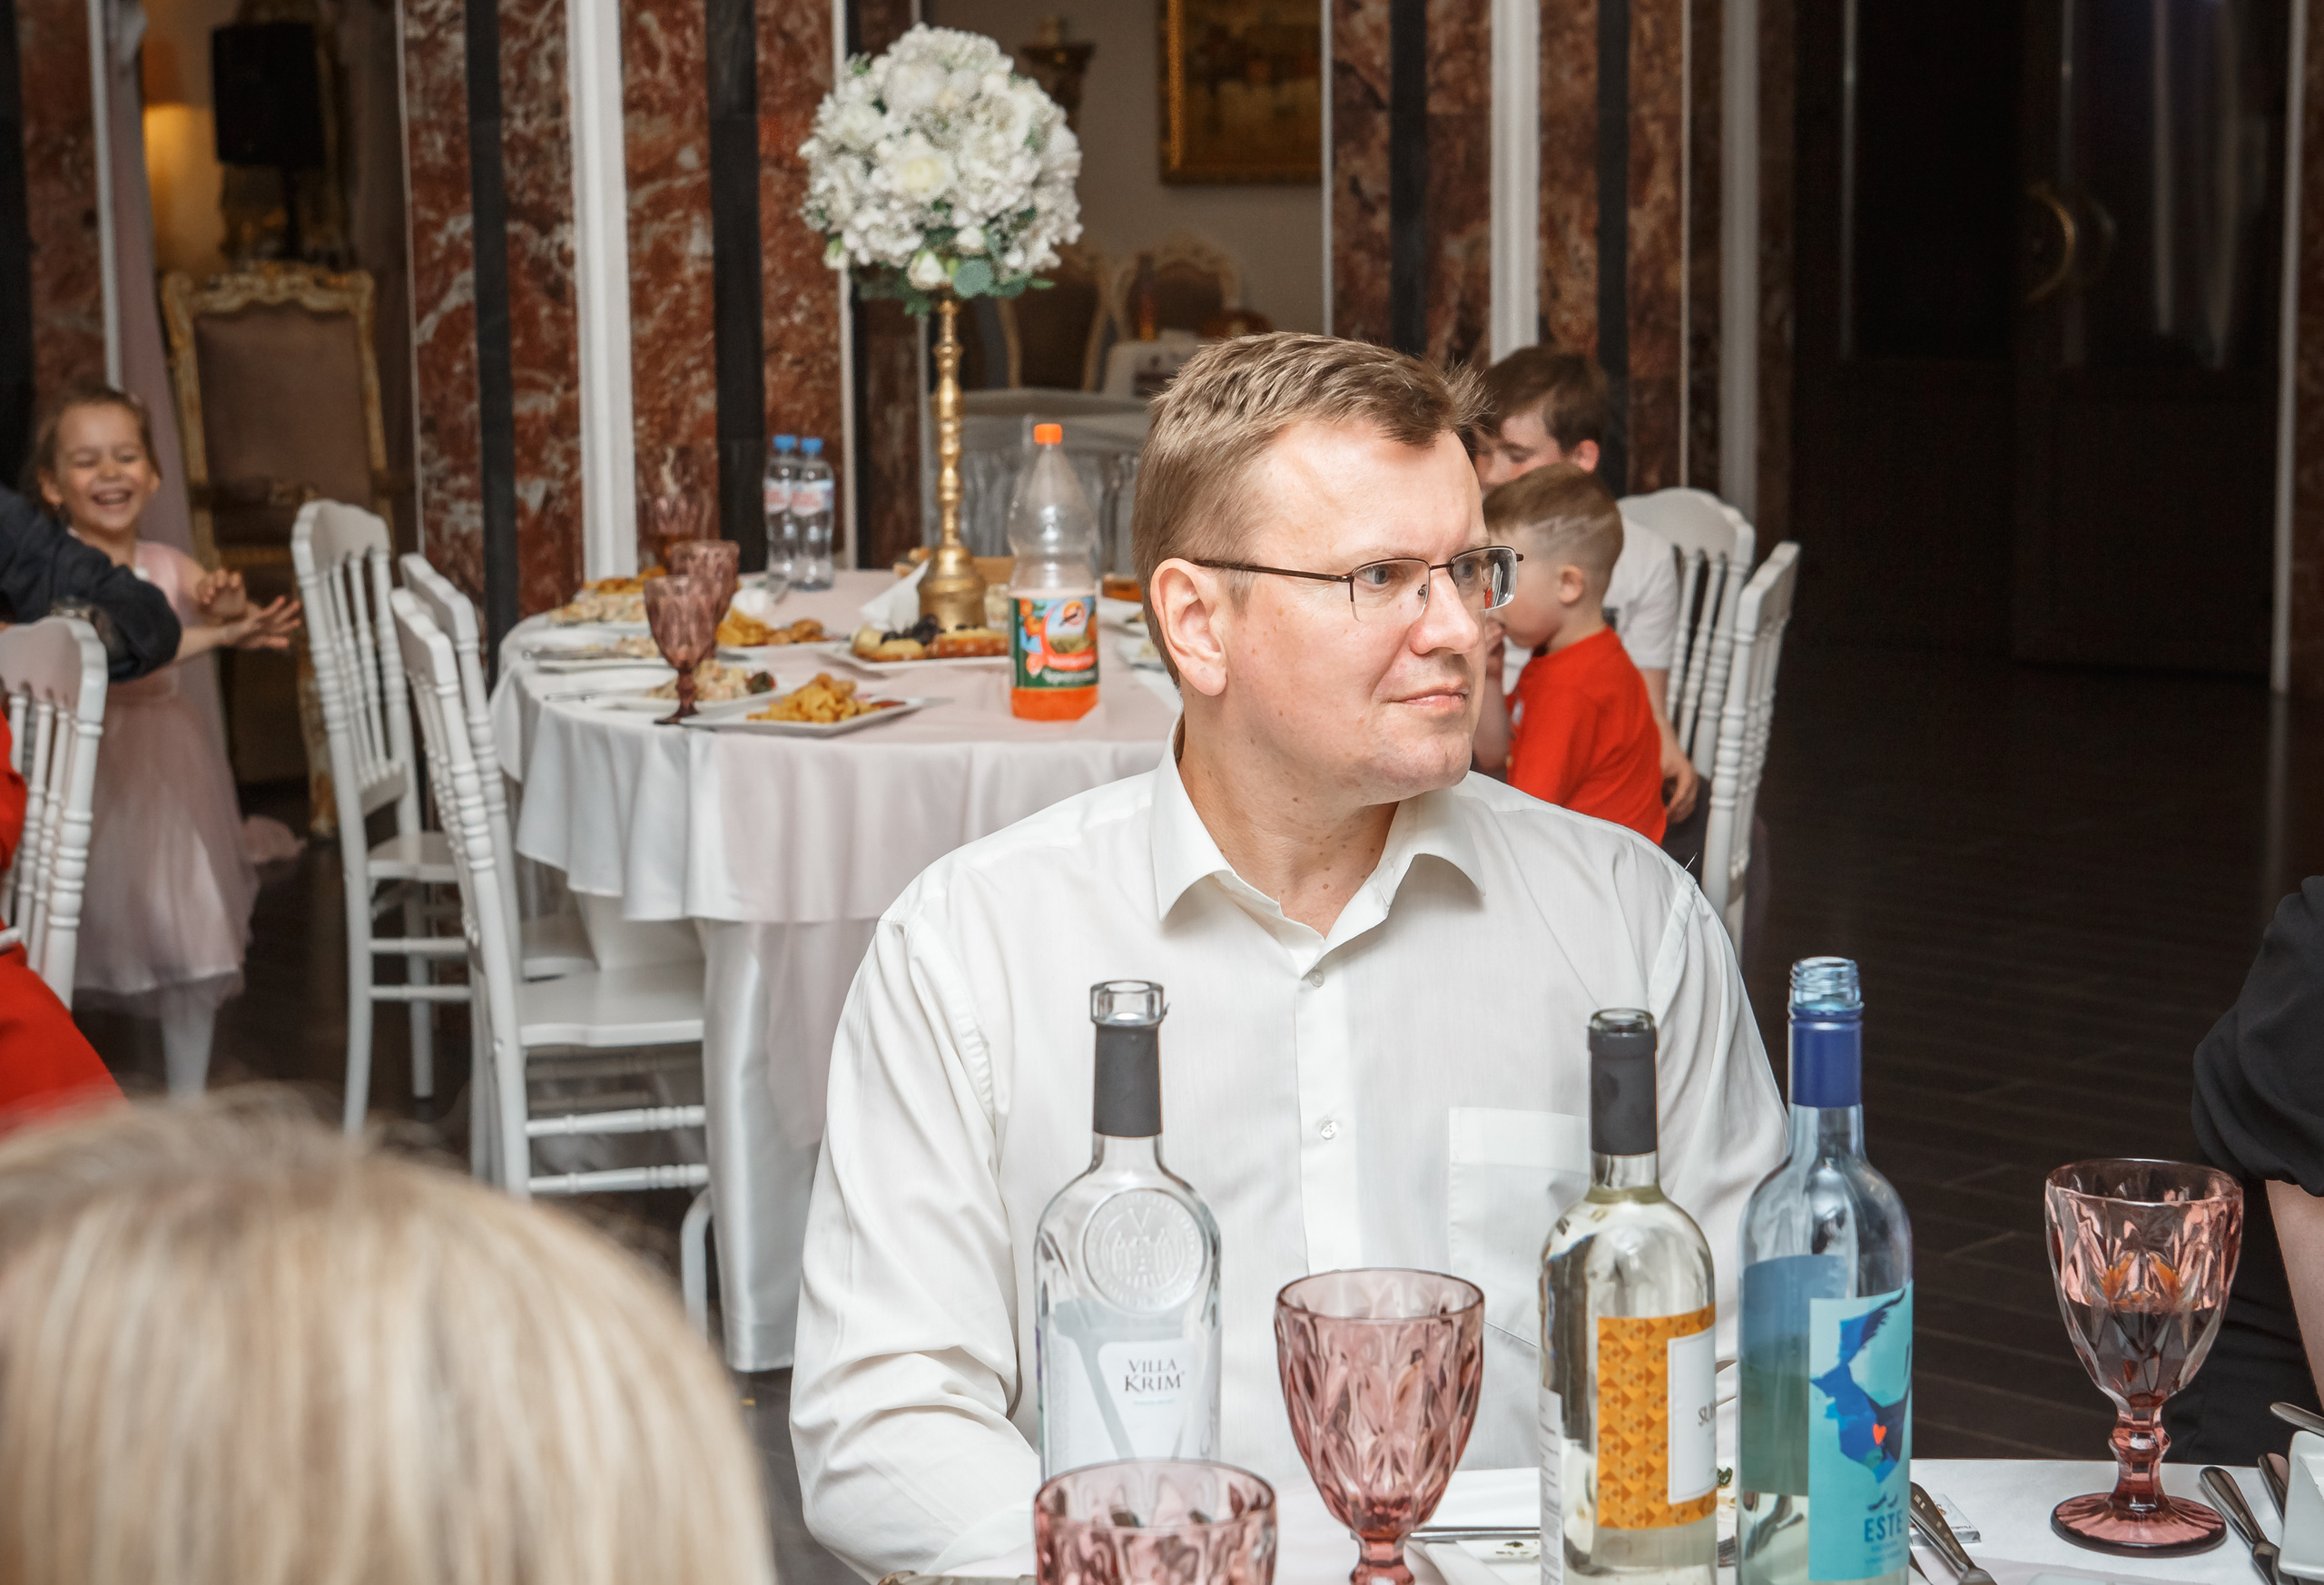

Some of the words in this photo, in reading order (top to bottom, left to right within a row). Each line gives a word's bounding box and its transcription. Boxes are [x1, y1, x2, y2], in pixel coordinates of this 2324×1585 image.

[1128, 1358, 1177, 1373] VILLA
[1125, 1373, 1181, 1393] KRIM
[1864, 1509, 1903, 1542] ESTE
